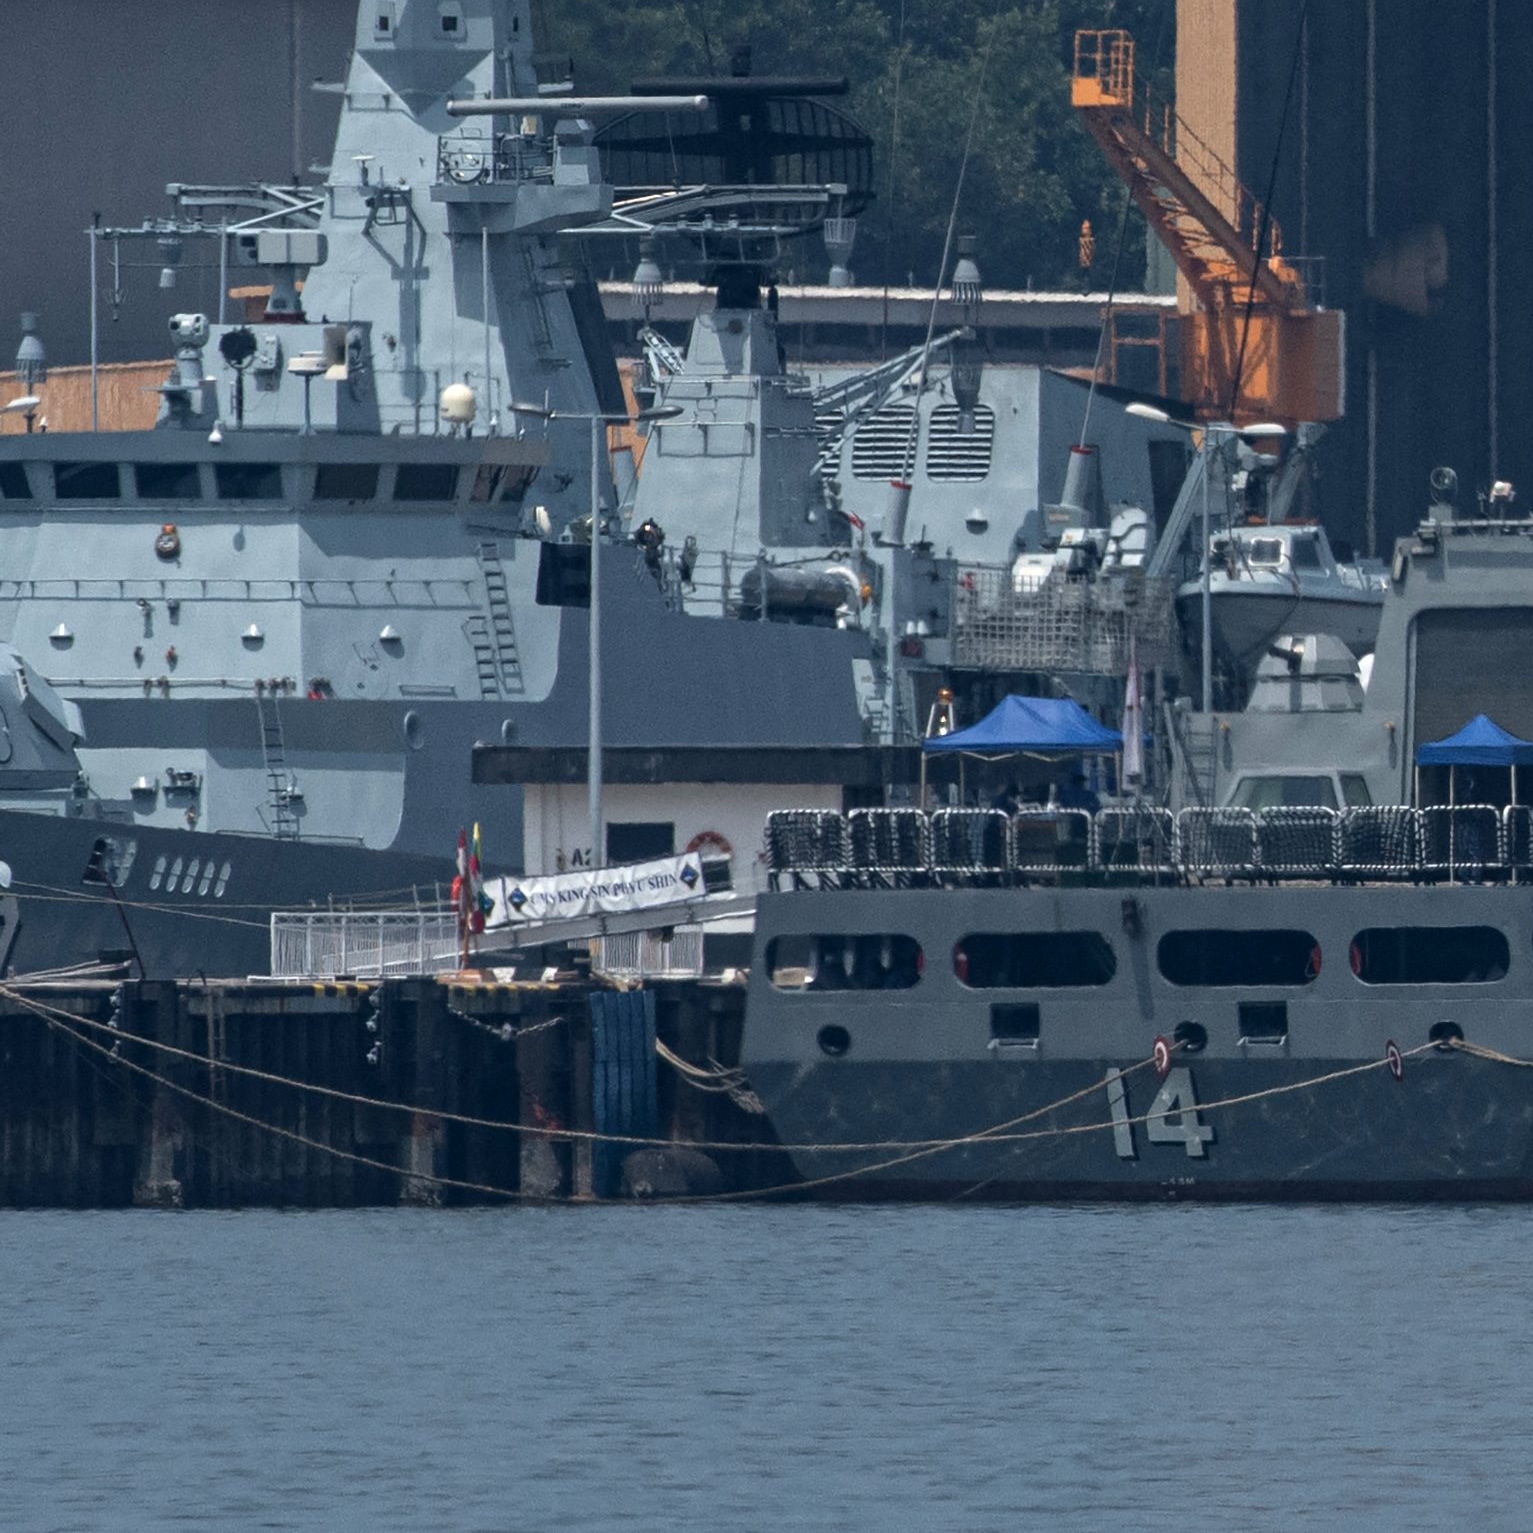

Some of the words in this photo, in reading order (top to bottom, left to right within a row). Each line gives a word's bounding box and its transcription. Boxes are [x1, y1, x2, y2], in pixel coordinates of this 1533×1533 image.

[558, 886, 590, 903] KING
[590, 884, 610, 898] SIN
[648, 872, 679, 891] SHIN
[1105, 1067, 1213, 1157] 14
